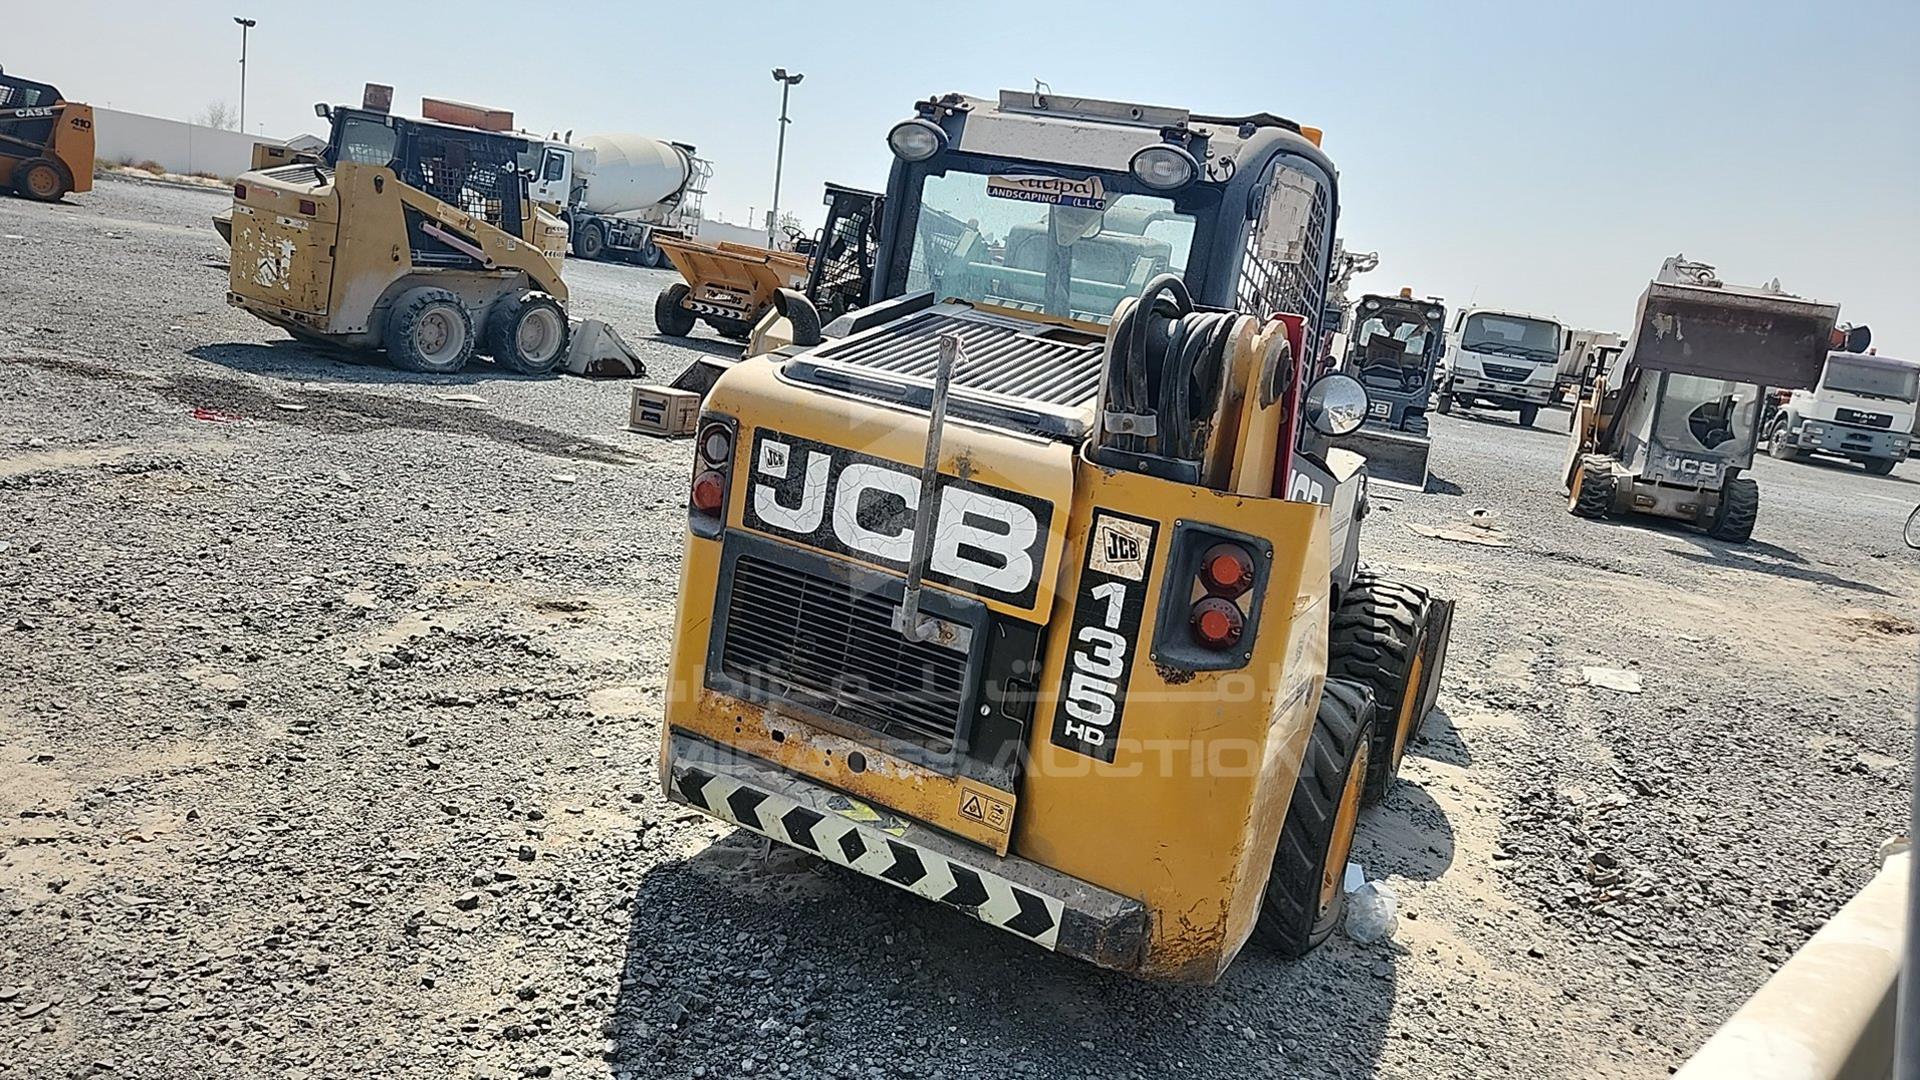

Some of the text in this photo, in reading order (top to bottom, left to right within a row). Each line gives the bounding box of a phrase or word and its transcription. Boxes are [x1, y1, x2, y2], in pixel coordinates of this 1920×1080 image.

[15, 107, 53, 118] CASE
[988, 187, 1056, 203] LANDSCAPING
[1852, 412, 1877, 420] MAN
[767, 449, 785, 466] JCB
[1666, 455, 1717, 477] JCB
[754, 450, 1038, 594] JCB
[1107, 532, 1139, 560] JCB
[1065, 581, 1127, 727] 135
[1065, 720, 1105, 747] HD
